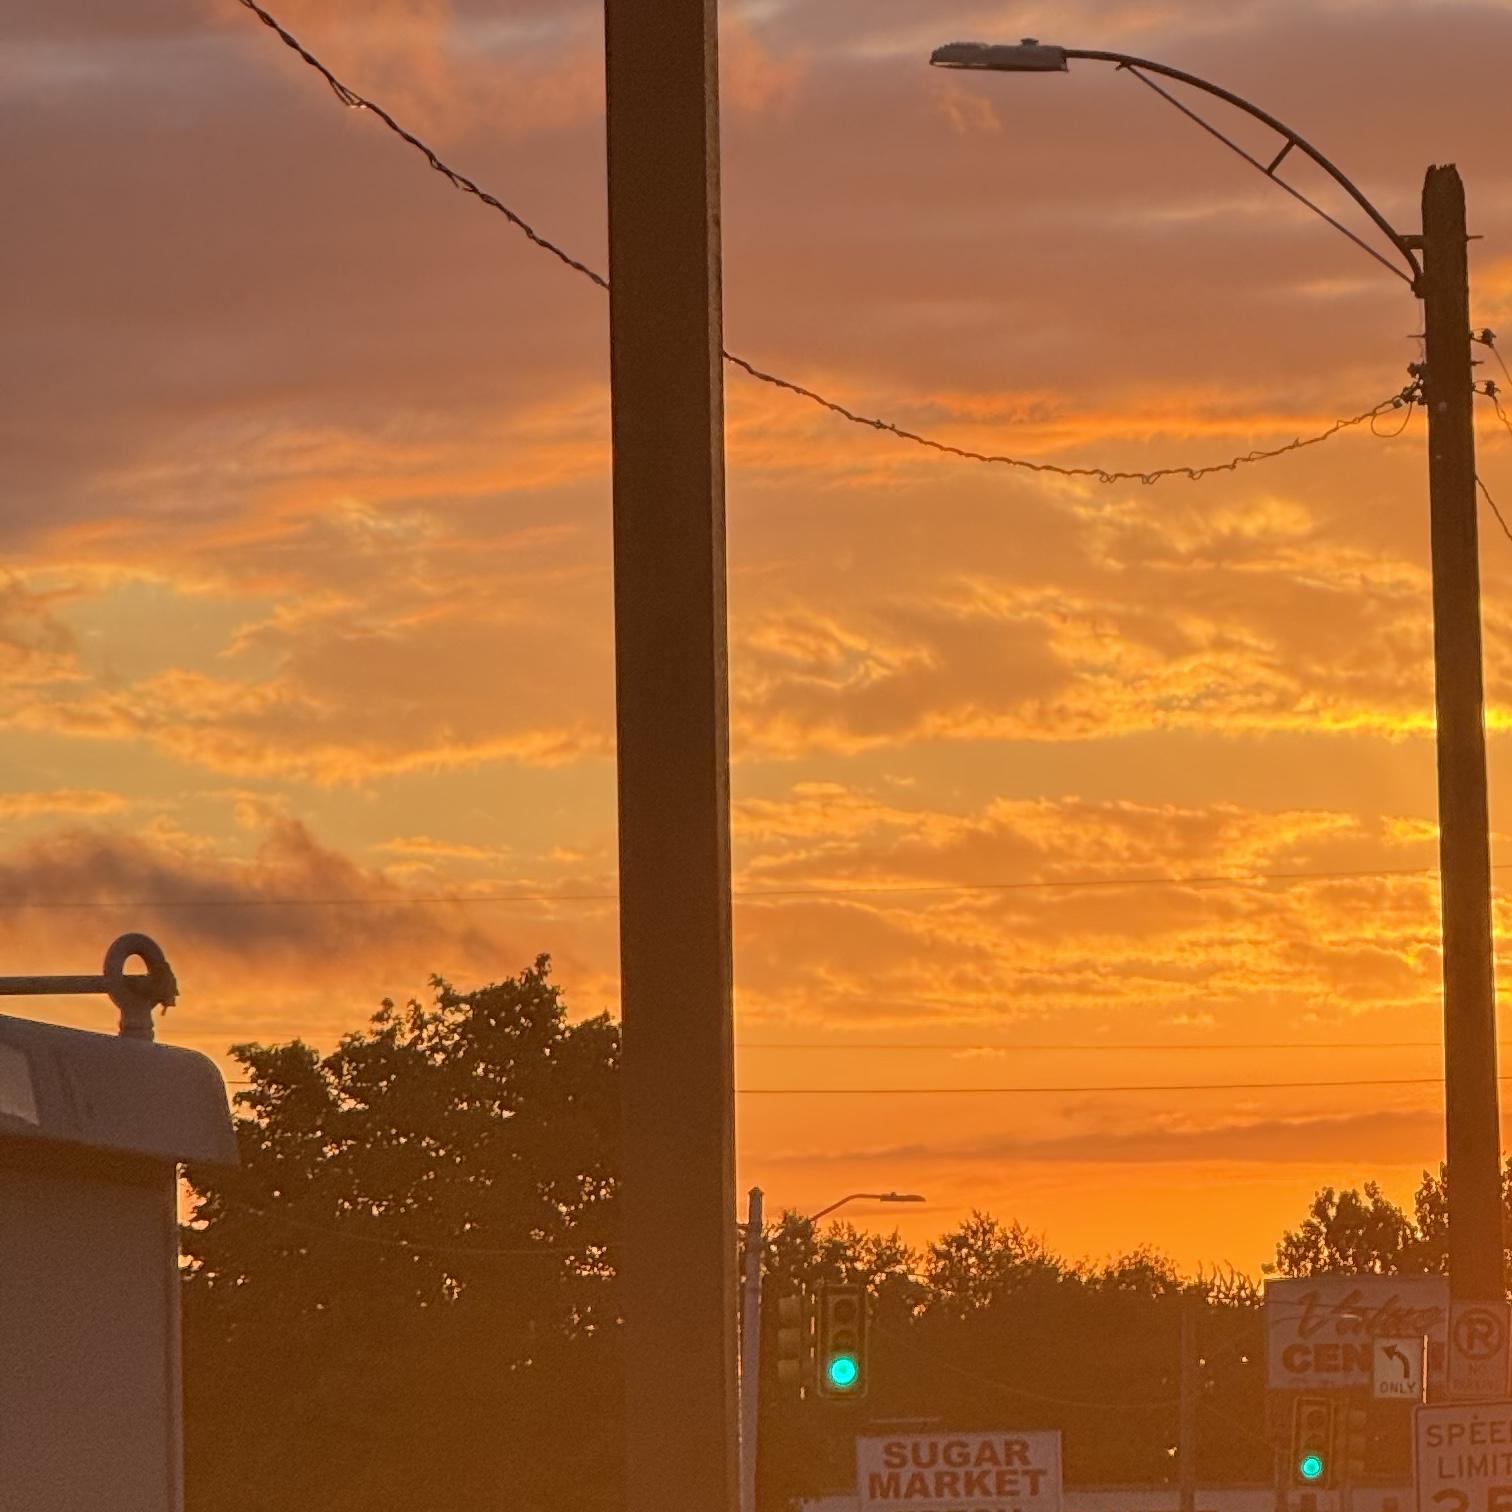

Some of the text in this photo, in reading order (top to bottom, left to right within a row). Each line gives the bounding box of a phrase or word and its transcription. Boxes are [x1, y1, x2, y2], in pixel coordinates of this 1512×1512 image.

[1379, 1382, 1416, 1394] ONLY
[883, 1440, 1031, 1469] SUGAR
[868, 1469, 1048, 1500] MARKET
